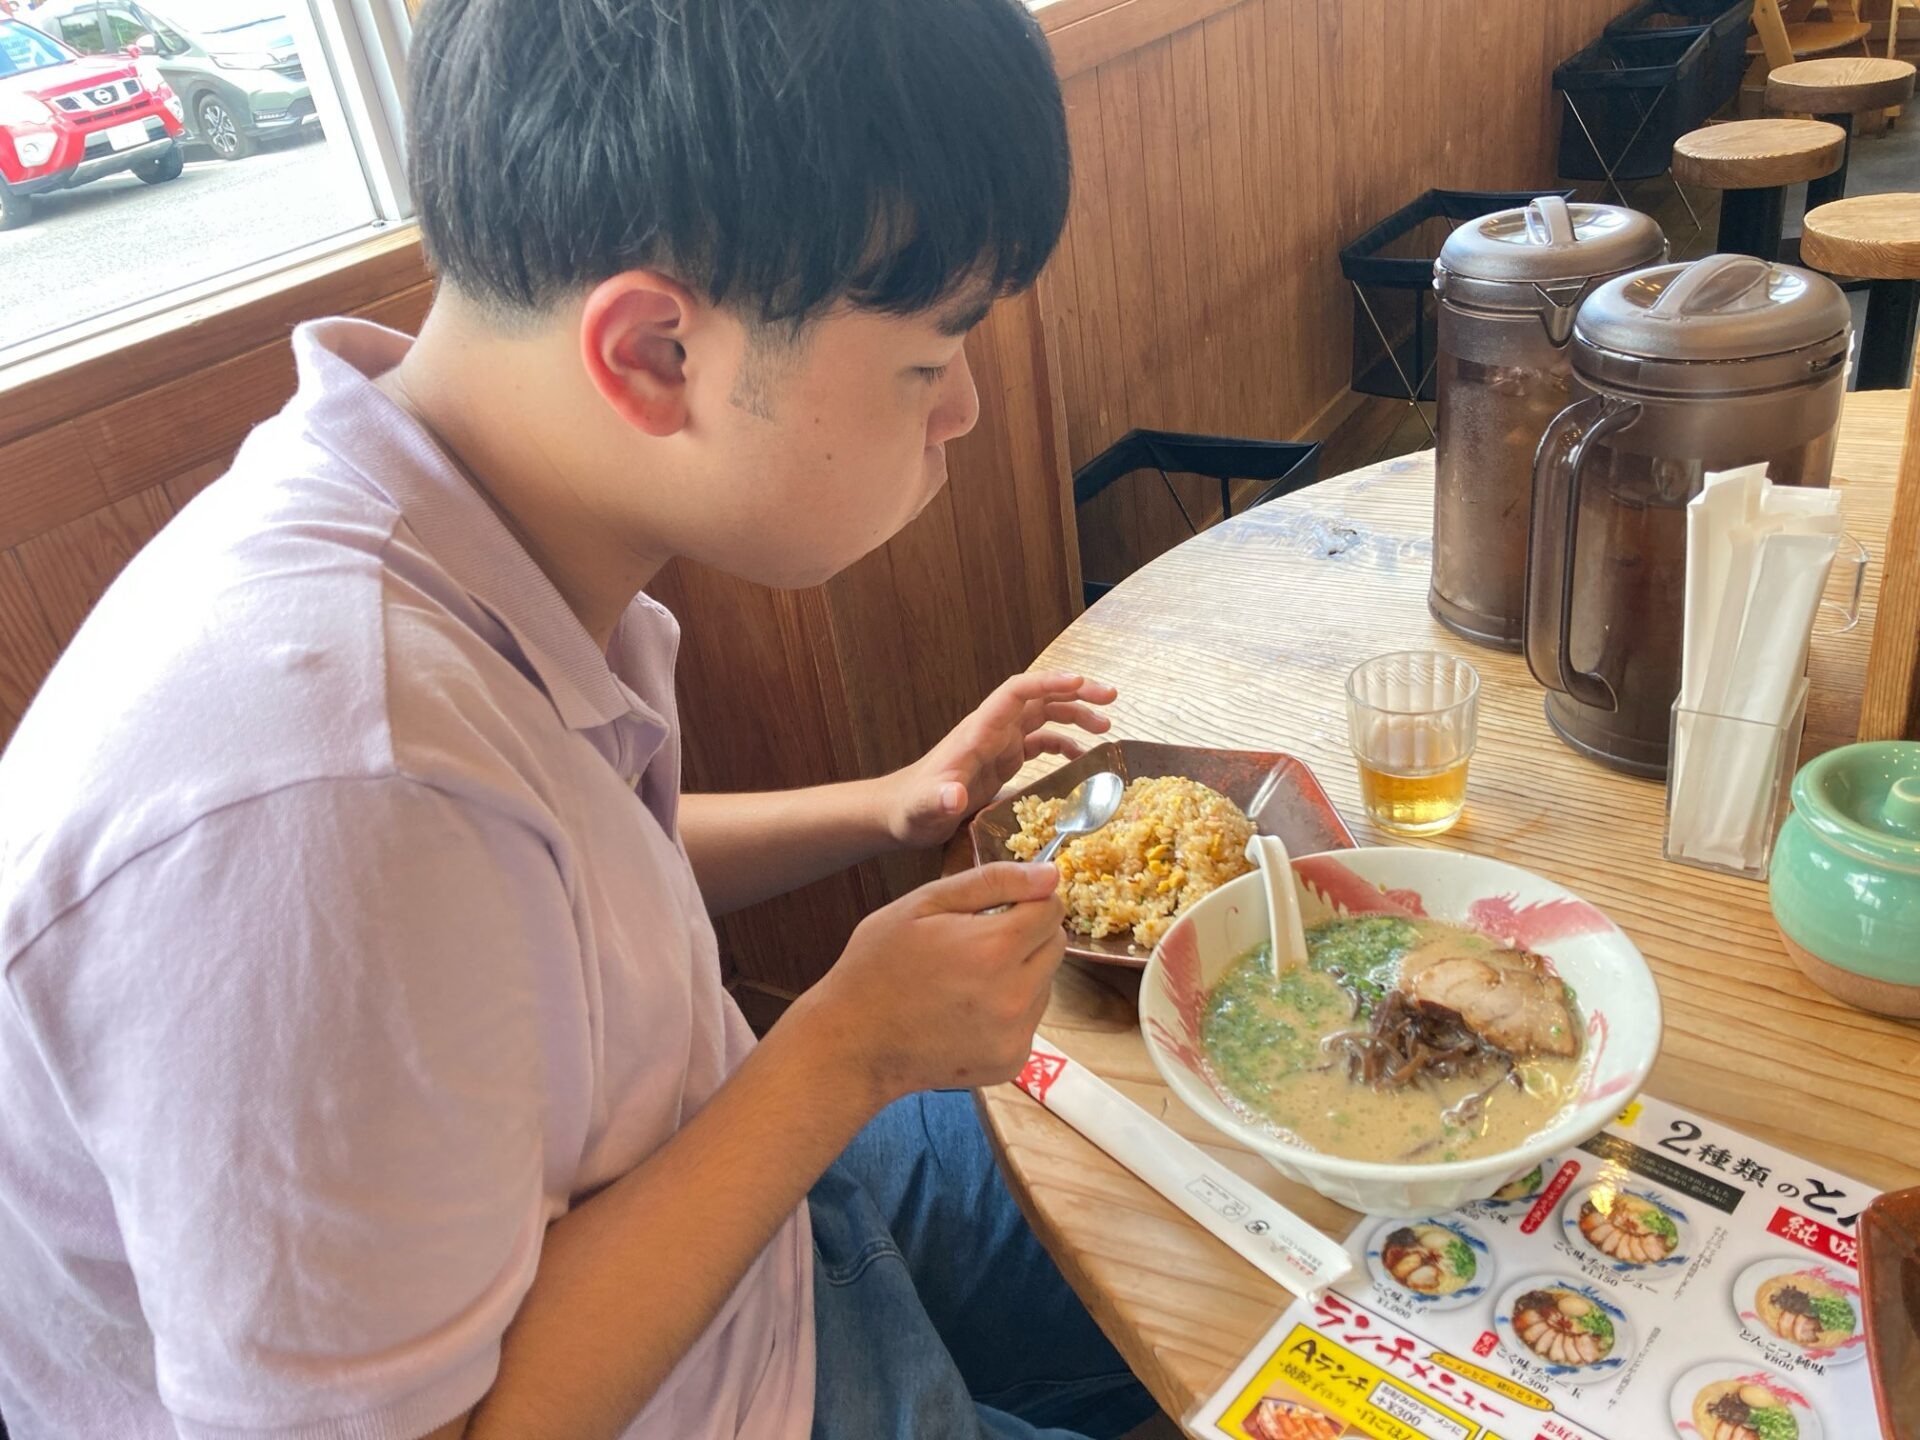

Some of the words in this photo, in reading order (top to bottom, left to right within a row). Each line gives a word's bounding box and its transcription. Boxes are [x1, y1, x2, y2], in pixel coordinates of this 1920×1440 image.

[1657, 1119, 1861, 1228] 2種類のと
[1289, 1338, 1370, 1393] Aランチ
[1313, 1295, 1506, 1418] ランチメニュー
[1510, 1369, 1549, 1395] ¥1,300
